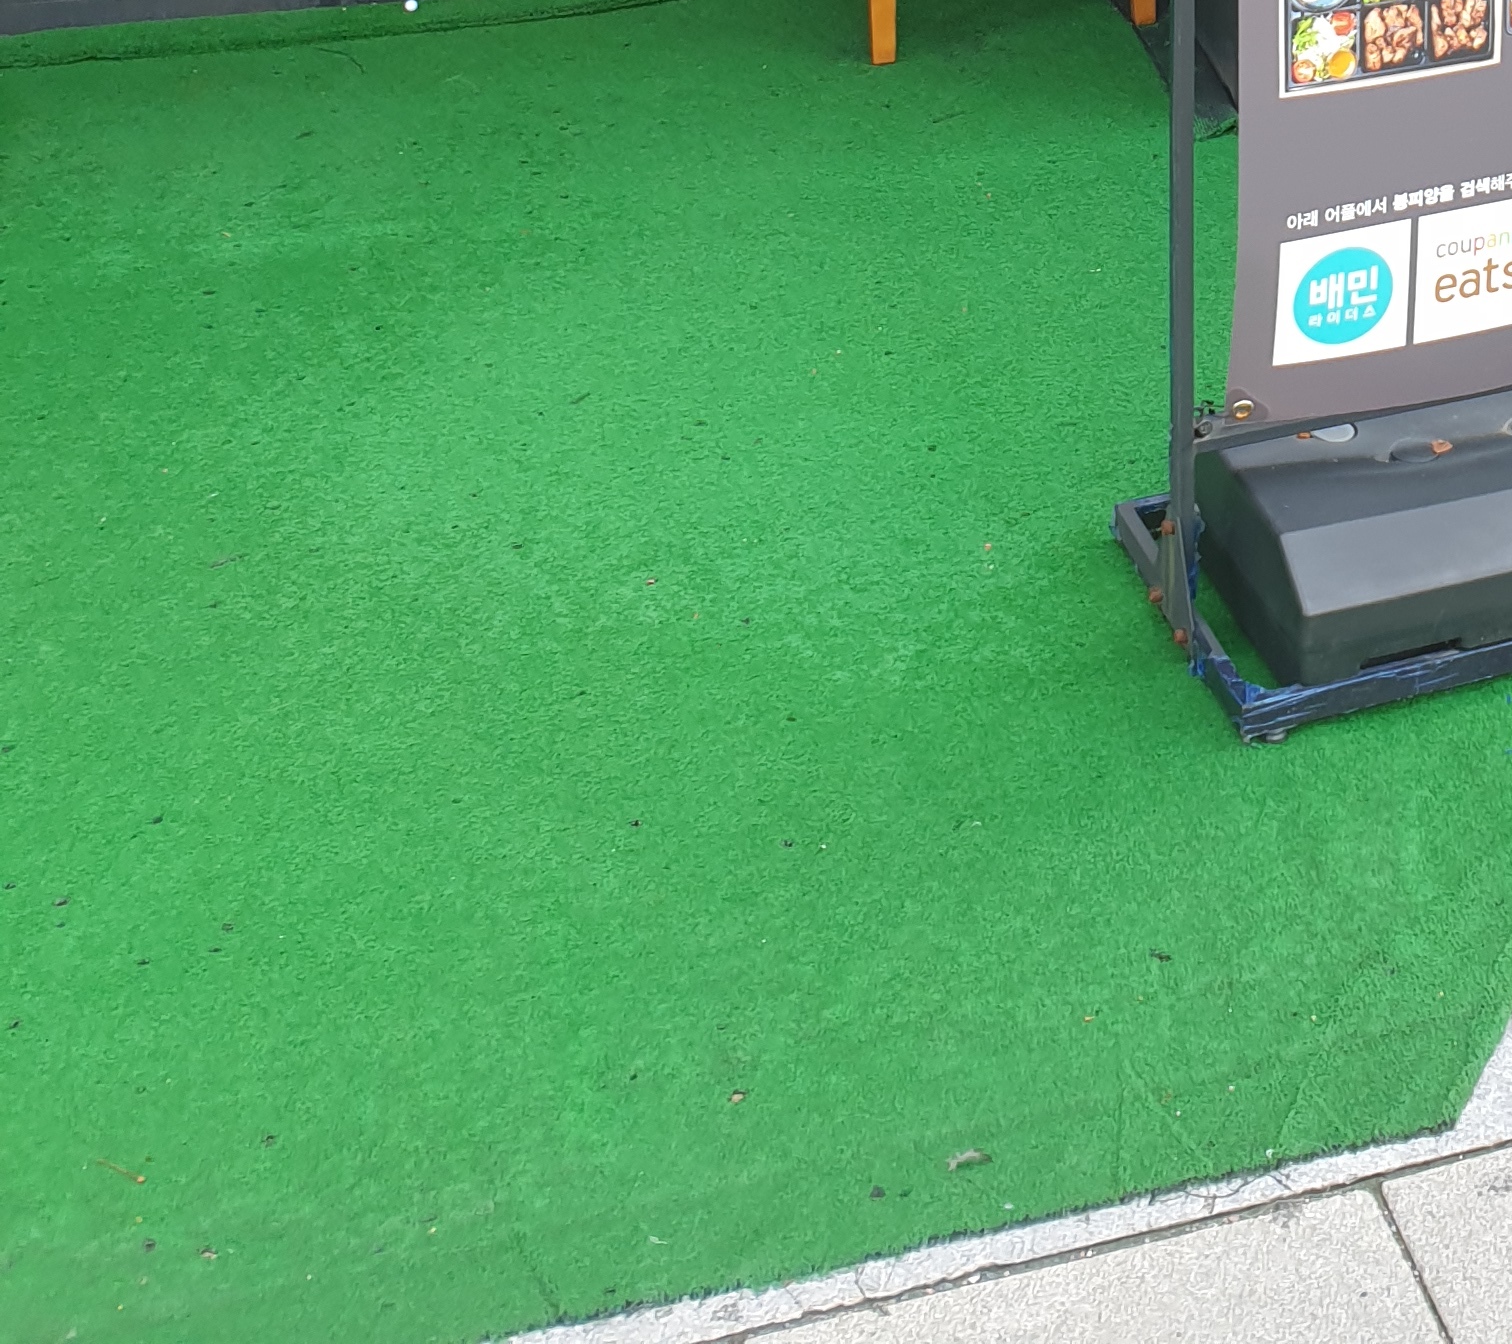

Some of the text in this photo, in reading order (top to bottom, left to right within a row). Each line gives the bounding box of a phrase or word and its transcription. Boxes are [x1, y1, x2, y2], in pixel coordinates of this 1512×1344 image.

[1286, 209, 1319, 231] 아래
[1324, 197, 1388, 223] 어플에서
[1392, 184, 1455, 212] 봉피양을
[1309, 264, 1380, 310] 배민
[1308, 305, 1377, 328] 라이더스
